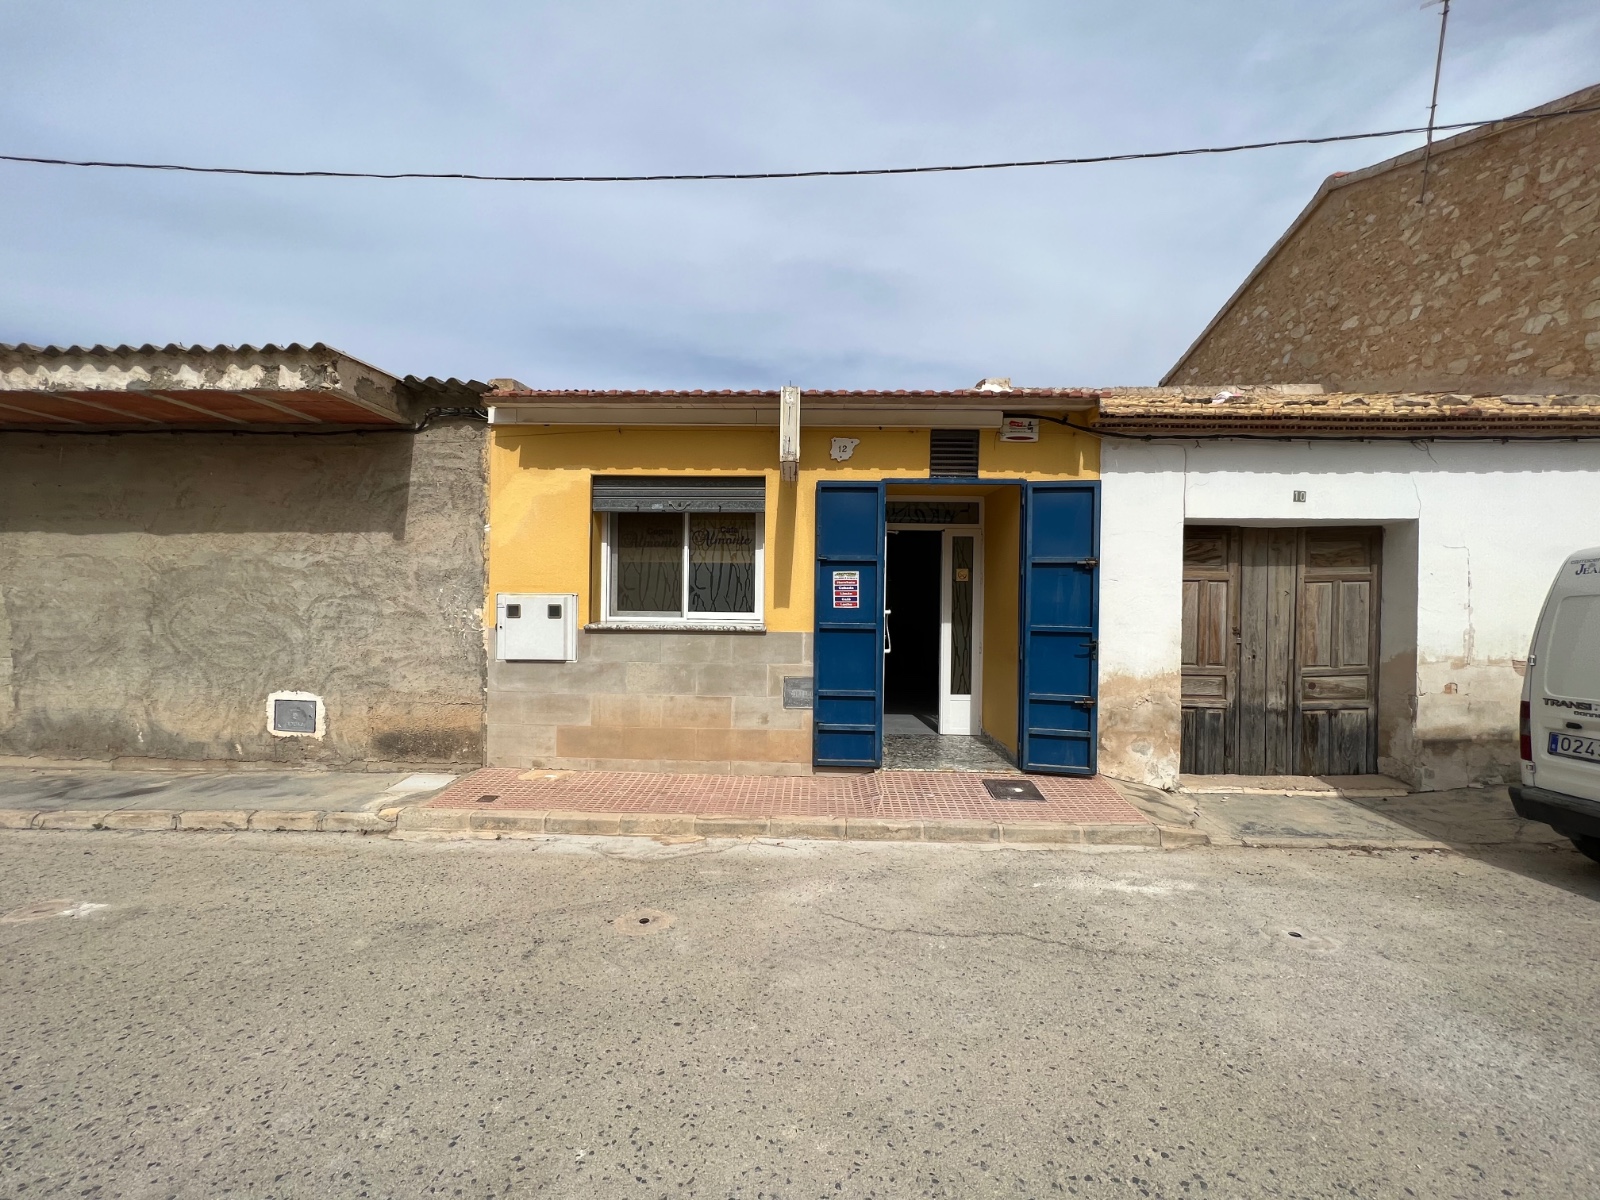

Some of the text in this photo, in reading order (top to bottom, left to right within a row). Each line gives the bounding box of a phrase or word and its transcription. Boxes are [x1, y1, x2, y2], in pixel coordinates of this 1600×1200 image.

[838, 444, 848, 453] 12
[1294, 491, 1306, 502] 10
[622, 530, 680, 548] Almonte
[692, 529, 753, 547] Almonte
